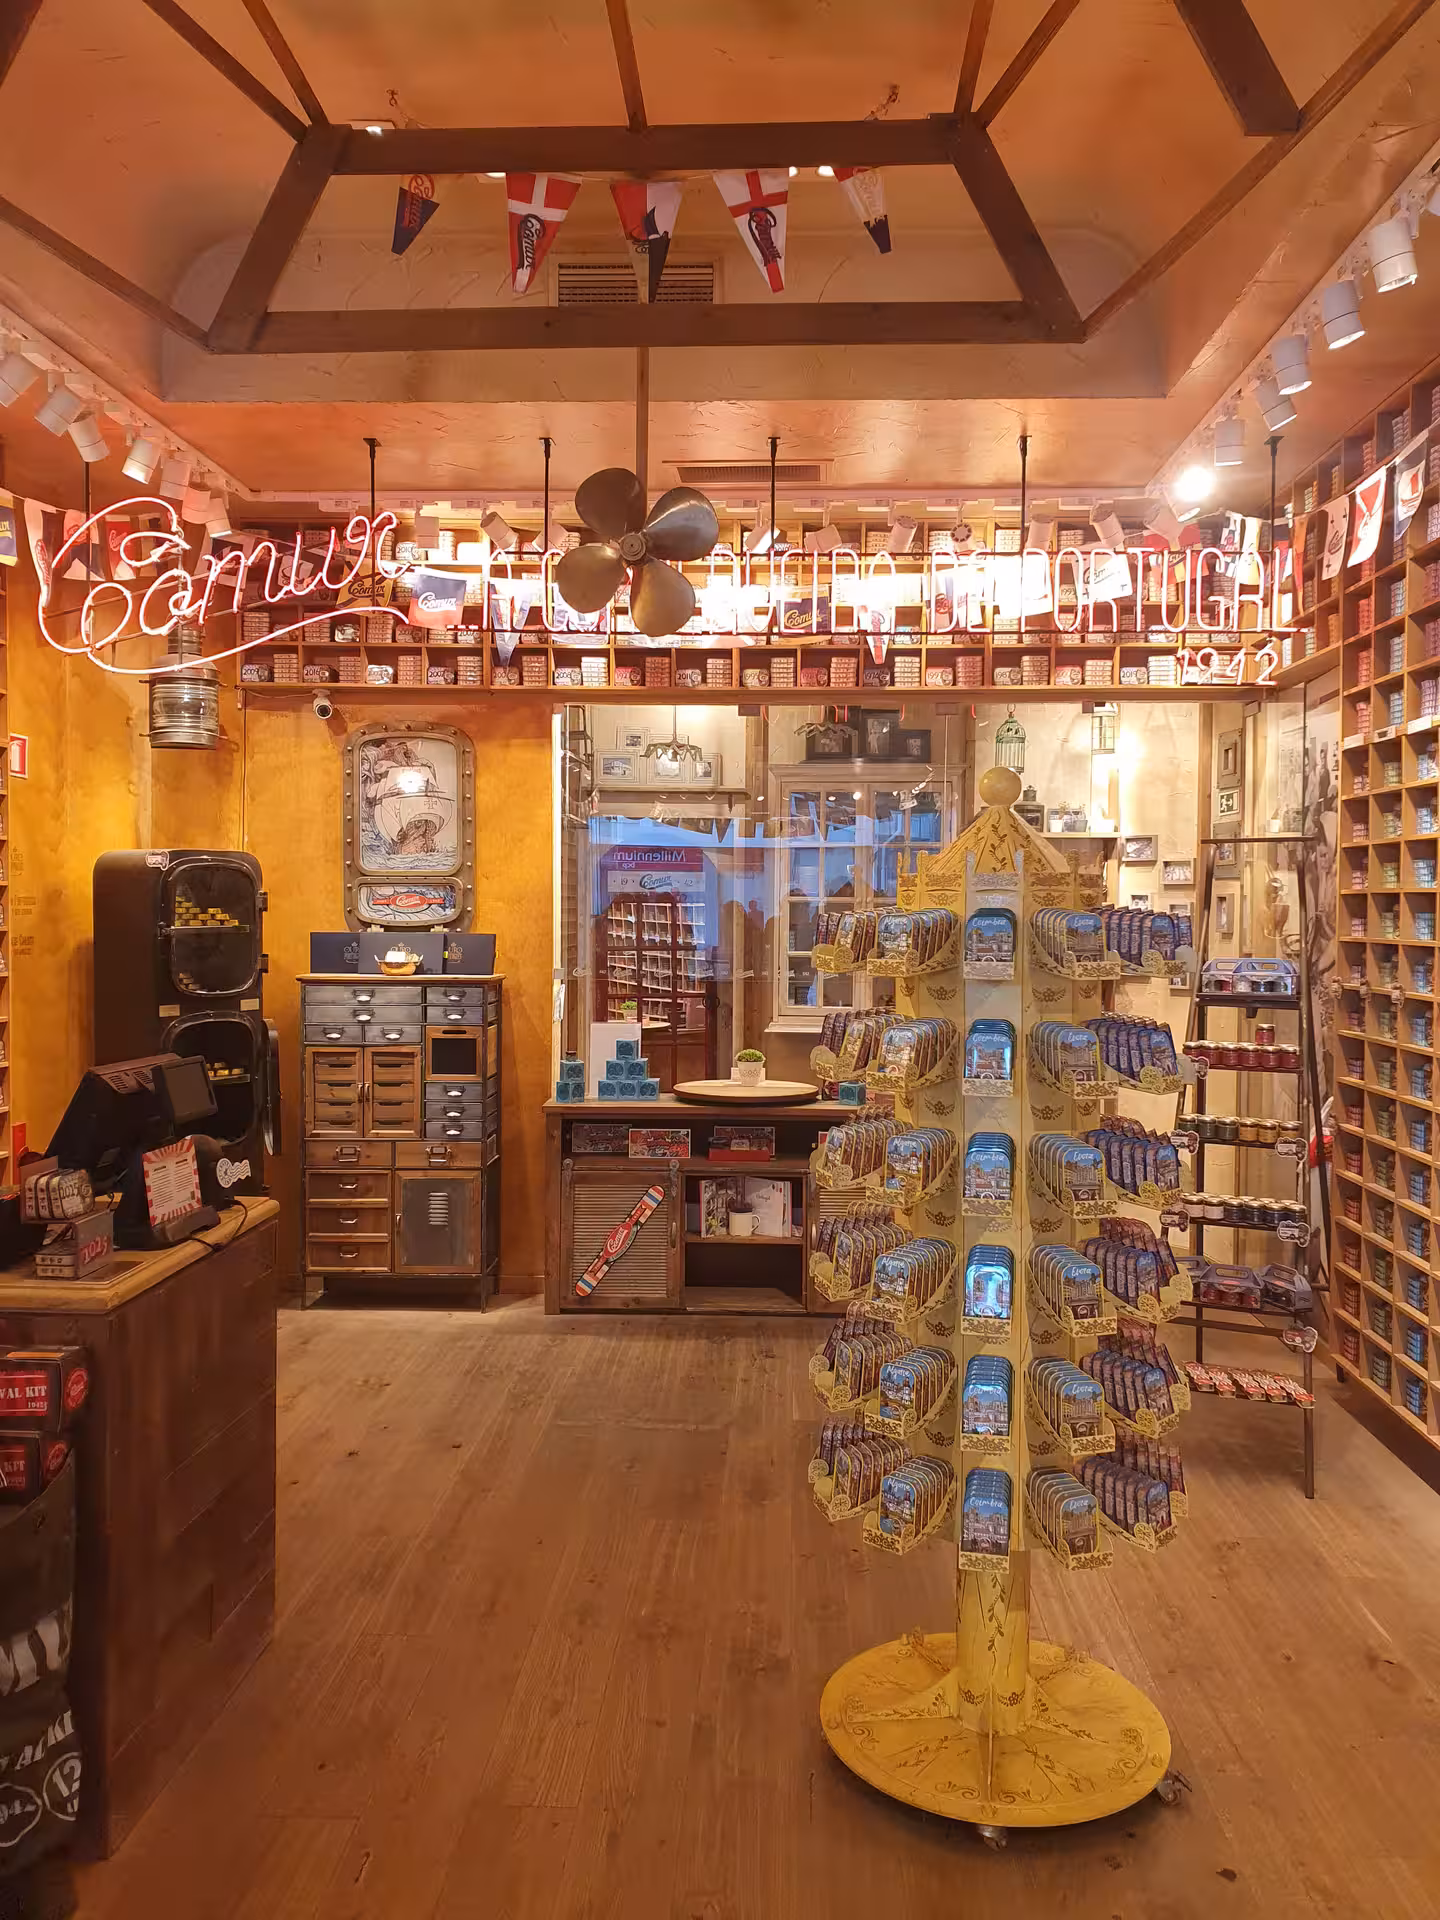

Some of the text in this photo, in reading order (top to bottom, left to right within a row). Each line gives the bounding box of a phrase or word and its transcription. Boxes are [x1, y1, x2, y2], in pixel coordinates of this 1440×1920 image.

[517, 213, 546, 271] Comur
[37, 497, 411, 674] Comur
[929, 547, 992, 633] DE
[1020, 546, 1302, 633] PORTUGAL
[348, 579, 386, 598] Comur
[417, 591, 458, 612] Comur
[1176, 637, 1280, 686] 1942
[639, 873, 673, 889] Comur
[972, 917, 1007, 927] Coimbra
[971, 1151, 1006, 1161] Coimbra
[25, 1385, 48, 1398] KIT
[969, 1496, 1004, 1508] Coimbra
